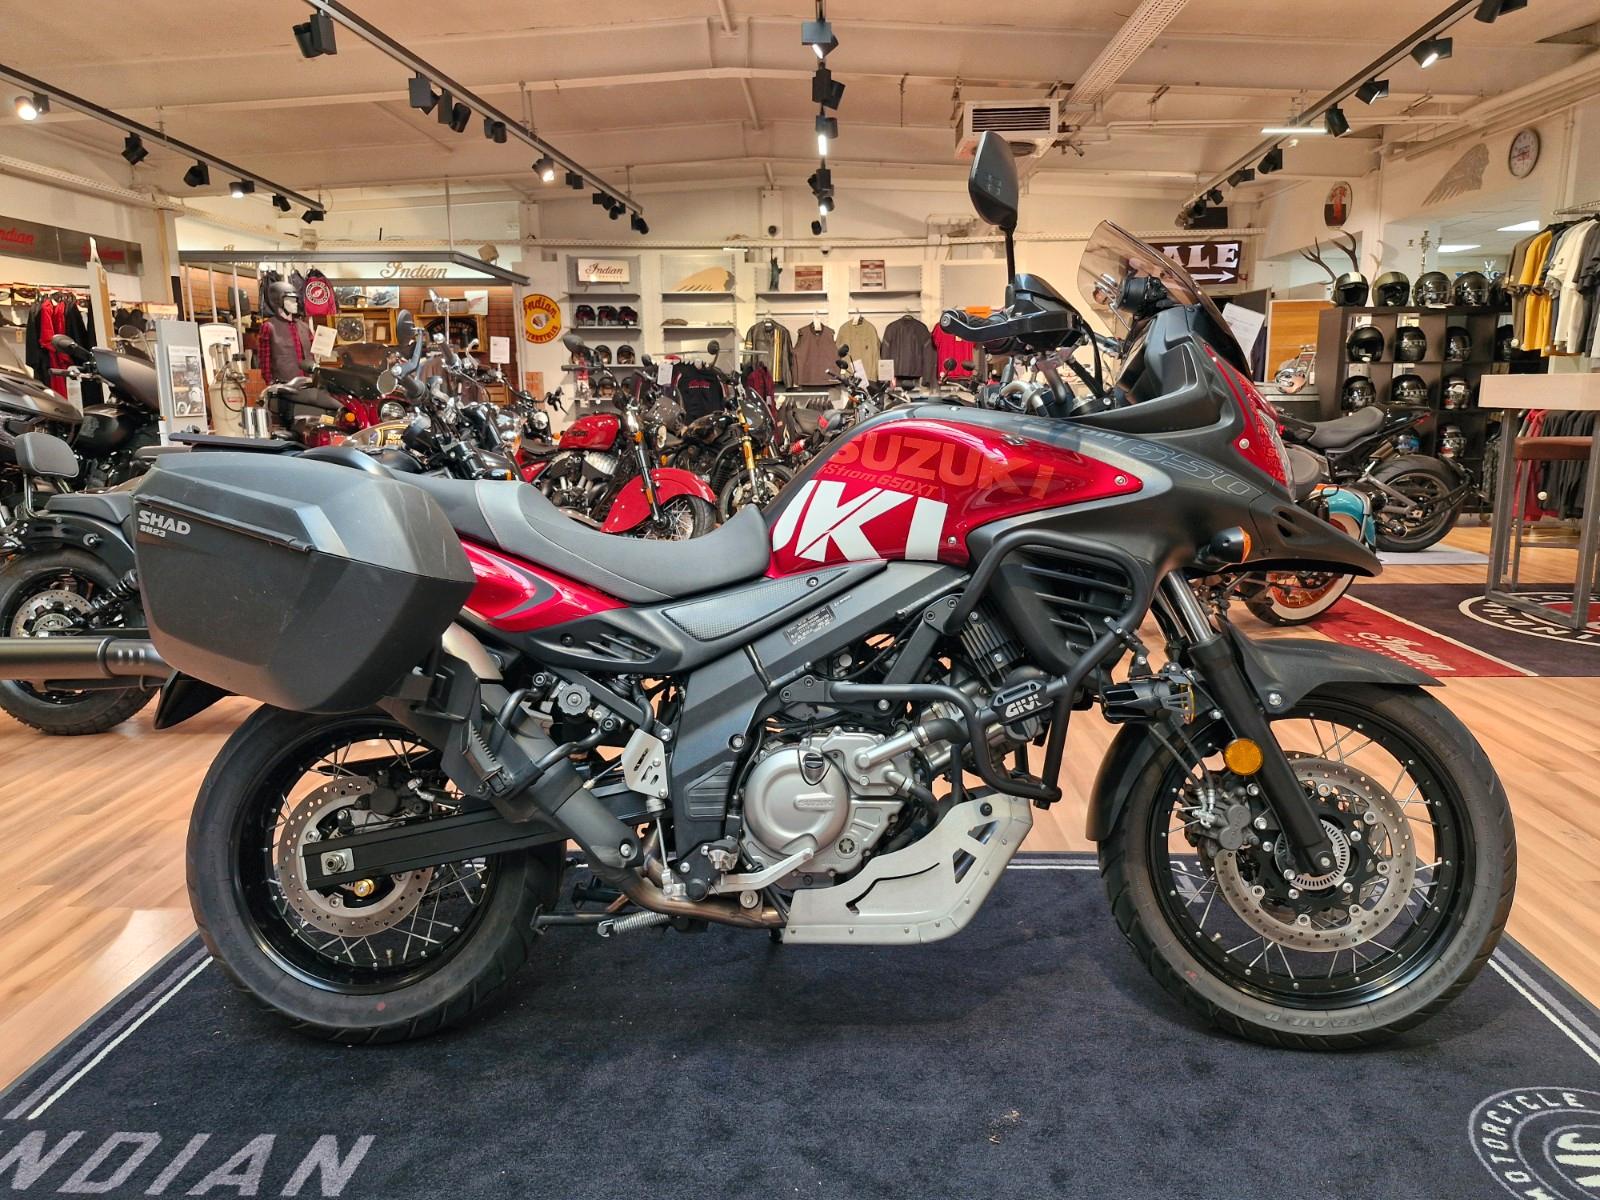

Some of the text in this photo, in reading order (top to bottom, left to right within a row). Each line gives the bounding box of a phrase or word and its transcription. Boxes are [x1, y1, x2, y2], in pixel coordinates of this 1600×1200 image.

[0, 227, 34, 245] ndian
[1162, 243, 1239, 269] ALE
[380, 261, 448, 279] Indian
[585, 262, 624, 276] Indian
[828, 431, 1054, 500] SUZUKI
[137, 509, 191, 535] SHAD
[1005, 693, 1042, 718] GIVI
[0, 1130, 377, 1198] NDIAN
